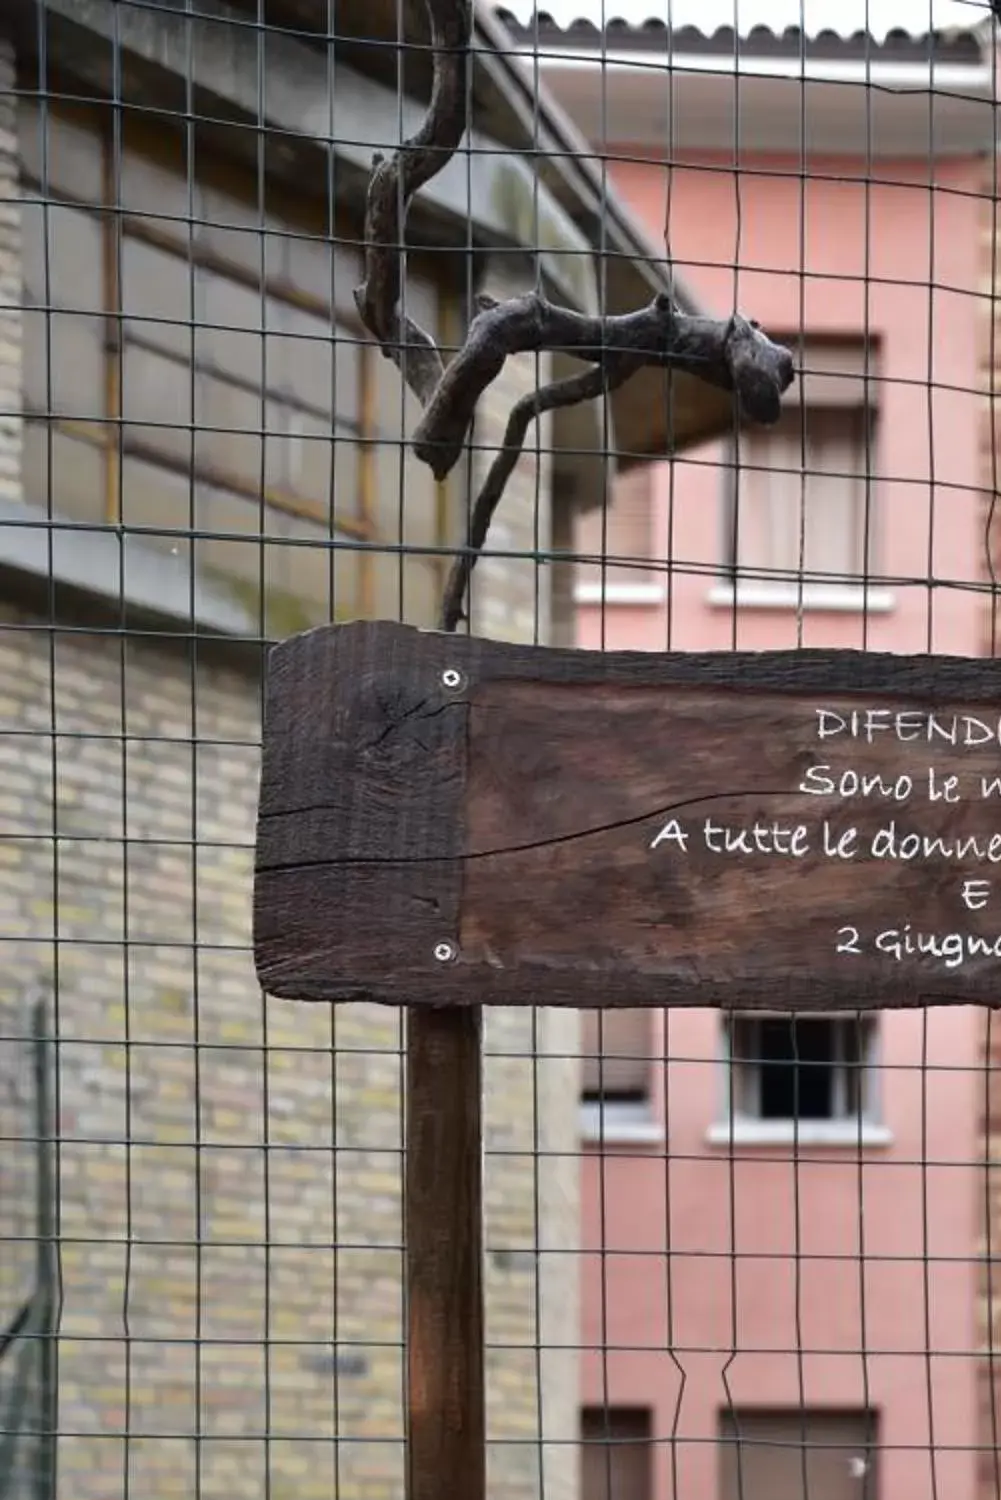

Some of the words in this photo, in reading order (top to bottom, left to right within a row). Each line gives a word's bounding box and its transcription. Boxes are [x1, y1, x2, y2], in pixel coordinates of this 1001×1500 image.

[798, 765, 913, 801] Sono
[928, 767, 961, 803] le
[650, 819, 689, 853] A
[703, 818, 810, 857] tutte
[823, 821, 858, 859] le
[961, 879, 990, 910] E
[836, 926, 862, 954] 2
